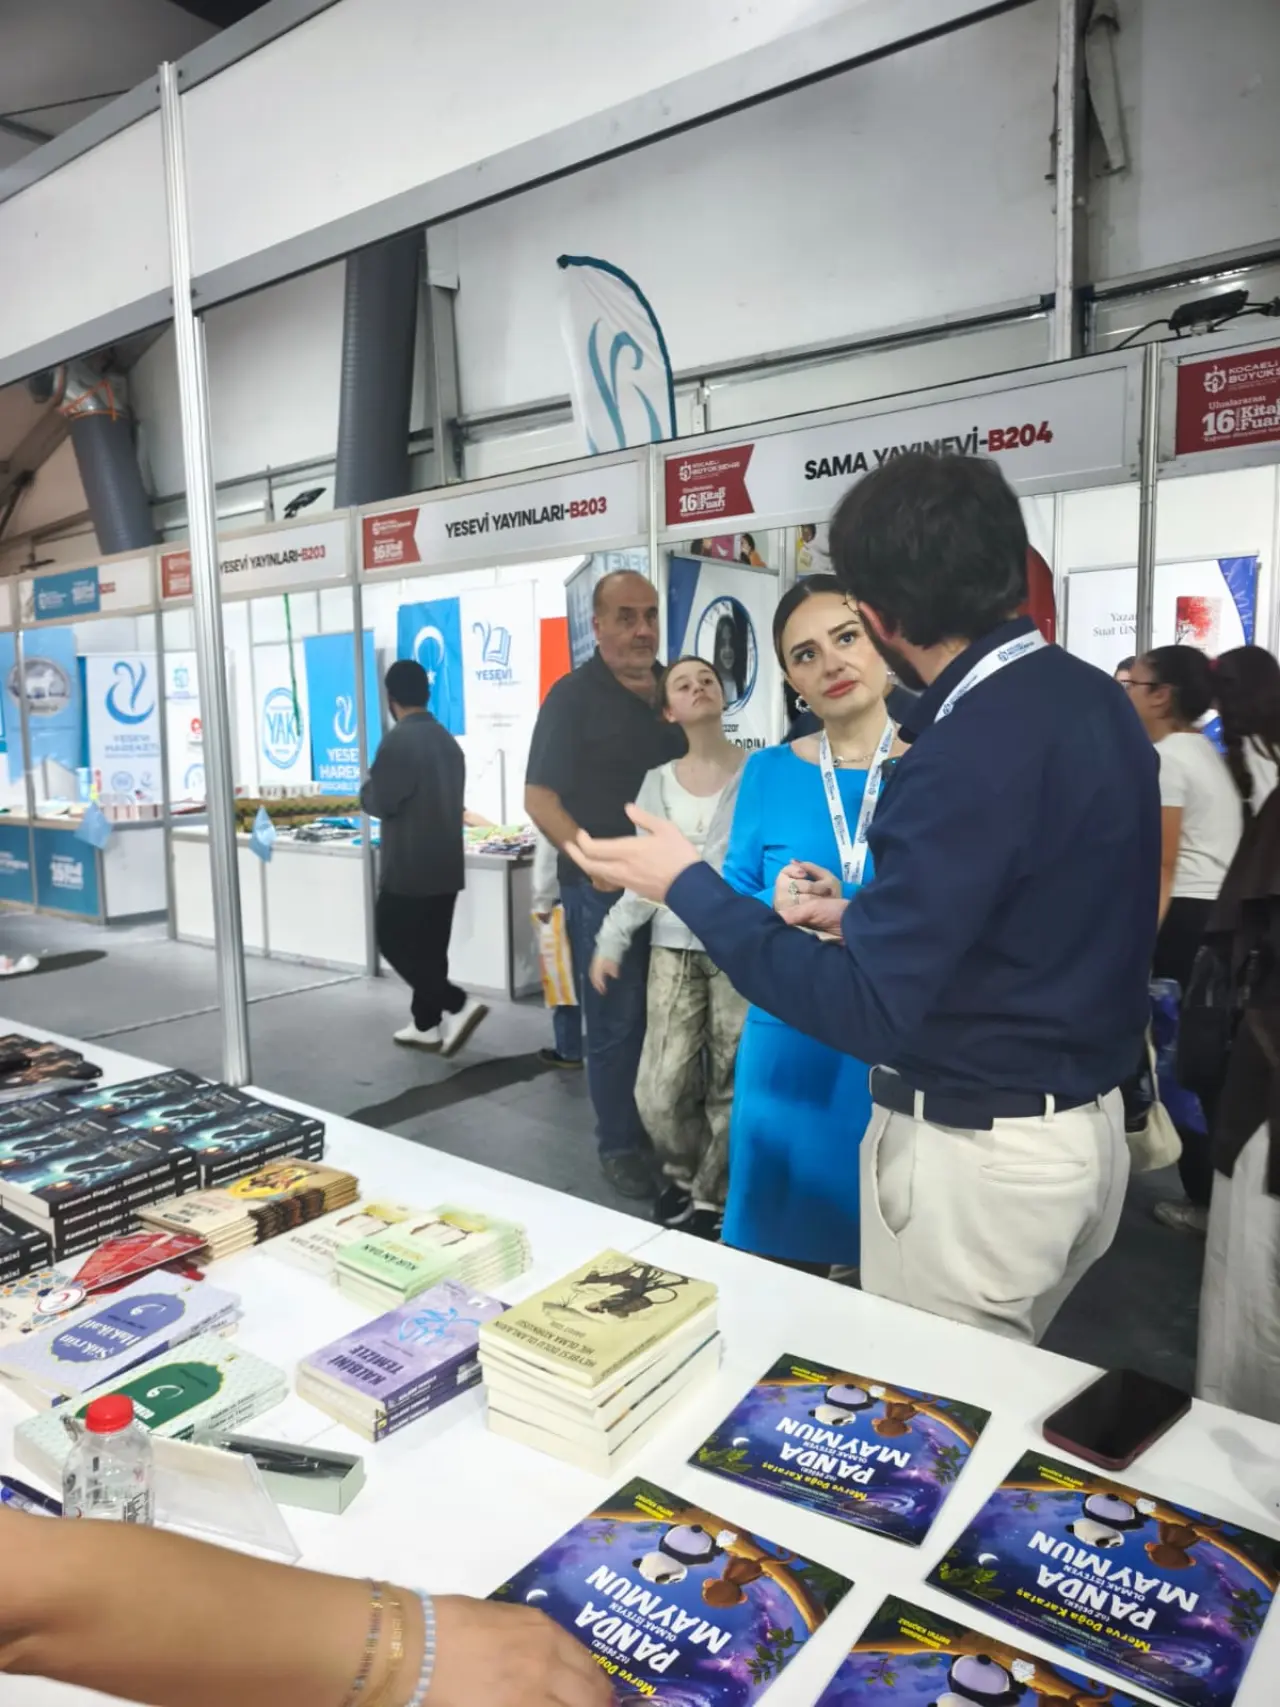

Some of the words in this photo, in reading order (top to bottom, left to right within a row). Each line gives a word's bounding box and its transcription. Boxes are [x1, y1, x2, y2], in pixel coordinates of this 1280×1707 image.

[1202, 409, 1235, 436] 16
[804, 452, 868, 481] SAMA
[679, 493, 698, 513] 16
[445, 512, 490, 538] YESEVİ
[492, 496, 607, 532] YAYINLARI-B203
[1110, 612, 1139, 622] Yaza
[327, 748, 360, 763] YESE
[327, 1354, 386, 1386] KALBİNİ
[348, 1344, 404, 1375] TEMİZLE
[775, 1417, 911, 1468] MAYMUN
[780, 1442, 876, 1485] PANDA
[834, 1451, 868, 1464] OLMAK
[803, 1477, 831, 1490] Doğa
[830, 1485, 868, 1501] Merve
[1028, 1530, 1199, 1612] MAYMUN
[1062, 1564, 1105, 1586] İSTEYEN
[1016, 1588, 1068, 1618] Karataş
[1036, 1564, 1157, 1630] PANDA
[1103, 1580, 1146, 1602] OLMAK
[585, 1565, 732, 1655] MAYMUN
[608, 1602, 647, 1628] İSTEYEN
[1068, 1611, 1104, 1632] Doğa
[575, 1601, 681, 1673] PANDA
[642, 1621, 677, 1643] OLMAK
[1104, 1627, 1151, 1653] Merve
[617, 1669, 657, 1697] Merve
